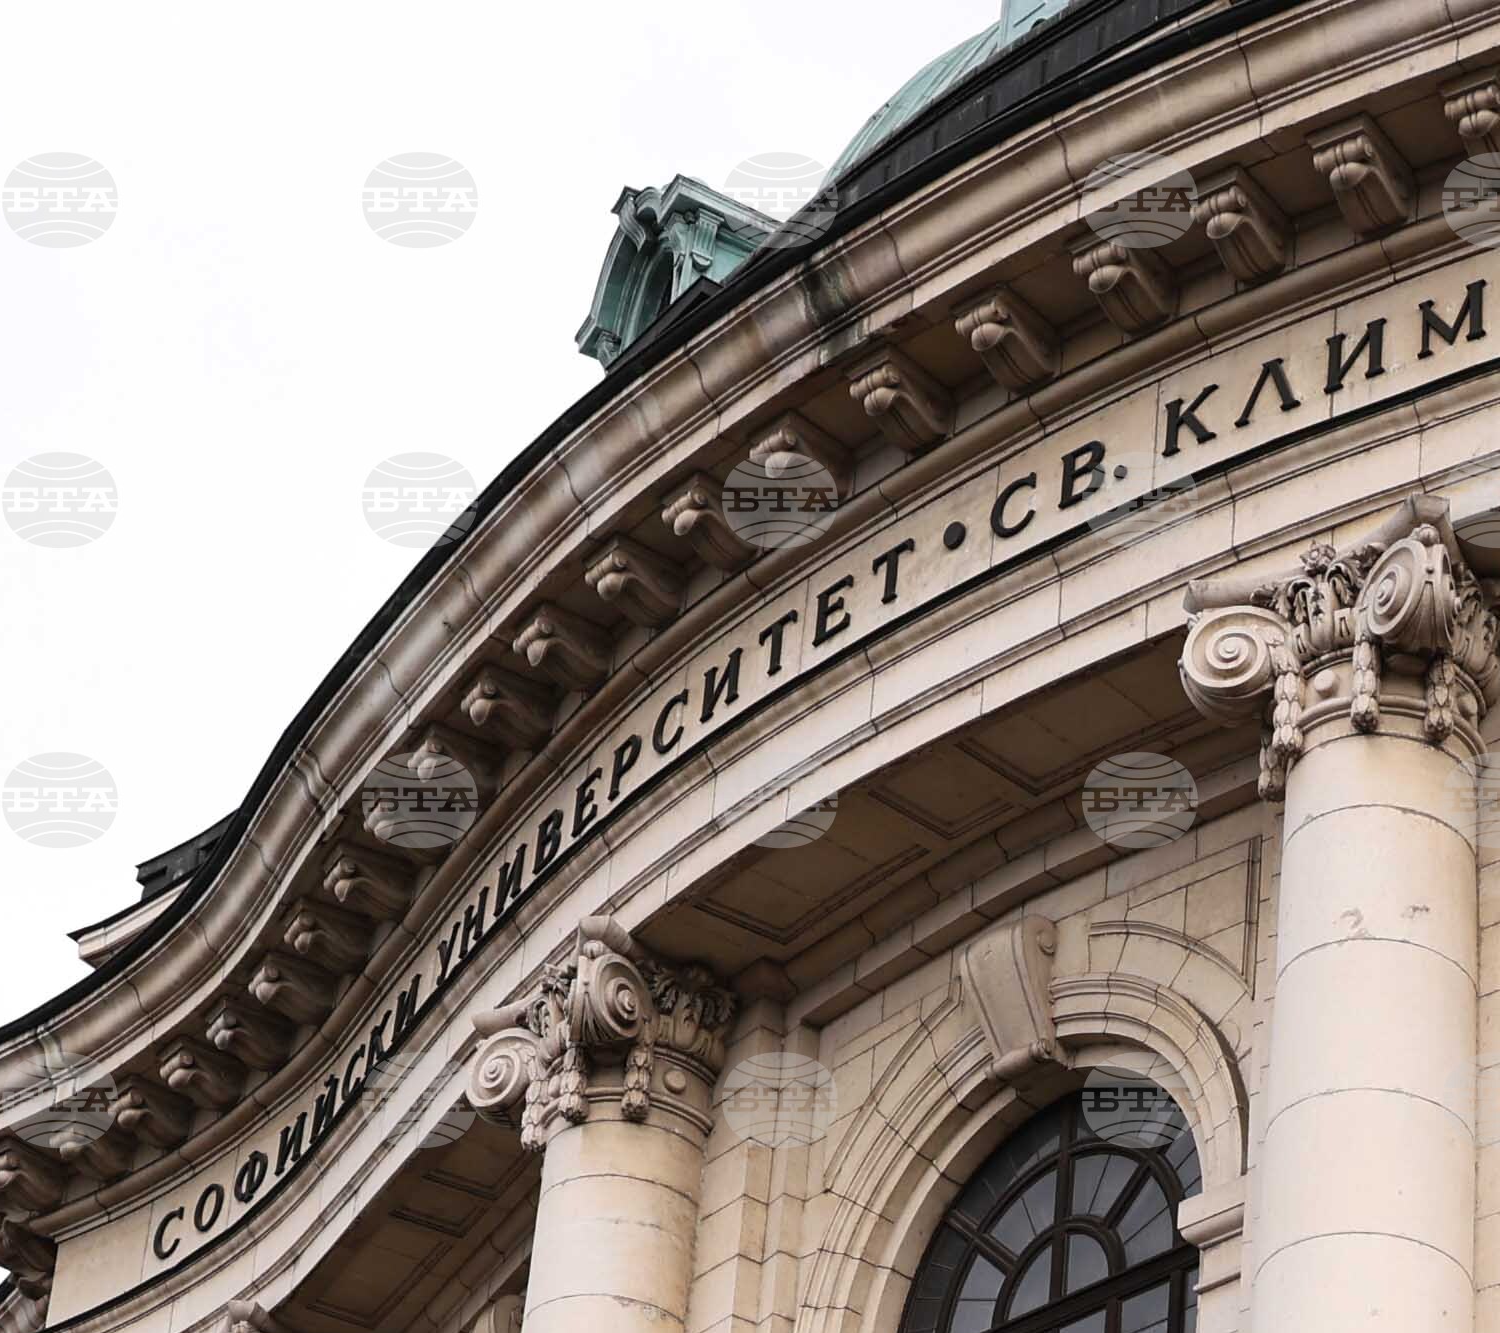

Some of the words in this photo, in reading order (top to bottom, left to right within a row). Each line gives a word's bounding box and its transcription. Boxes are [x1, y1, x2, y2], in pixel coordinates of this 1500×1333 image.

[153, 973, 423, 1261] СОФИЙСКИ
[435, 537, 915, 988] УНИВЕРСИТЕТ
[990, 440, 1128, 538] СВ.
